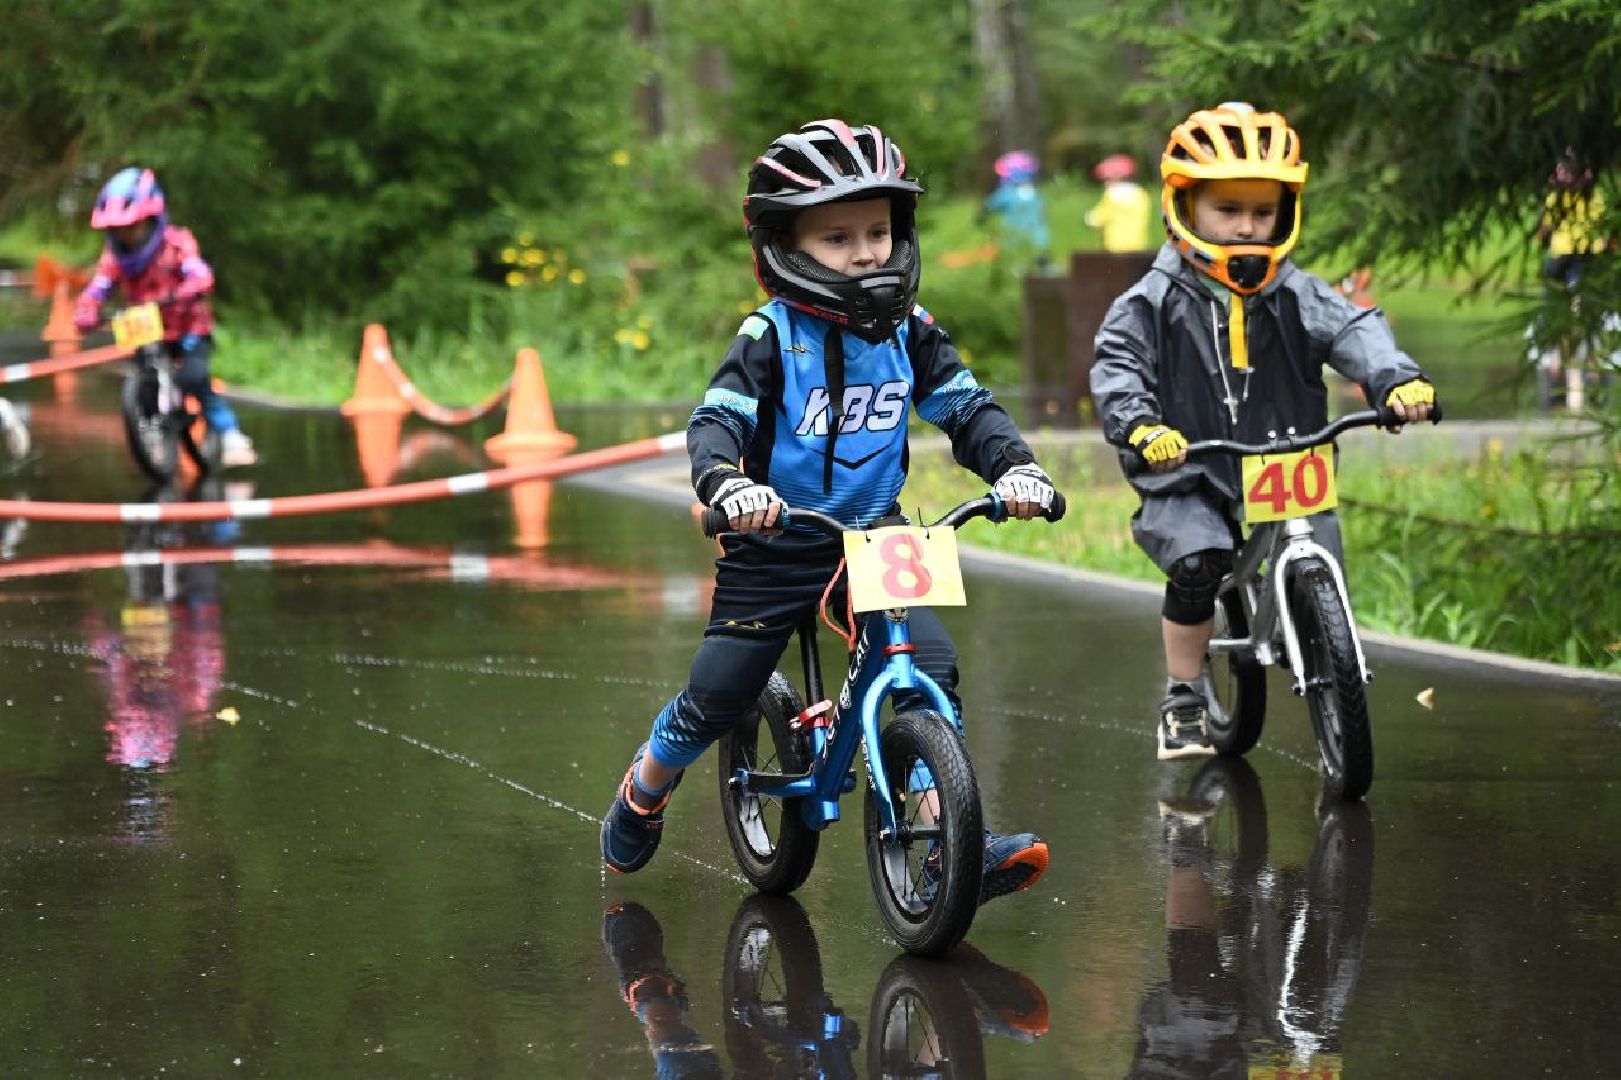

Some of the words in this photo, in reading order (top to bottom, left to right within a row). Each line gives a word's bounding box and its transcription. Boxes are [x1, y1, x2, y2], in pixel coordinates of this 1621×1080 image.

[795, 380, 911, 436] KBS
[1248, 454, 1328, 512] 40
[880, 533, 932, 598] 8
